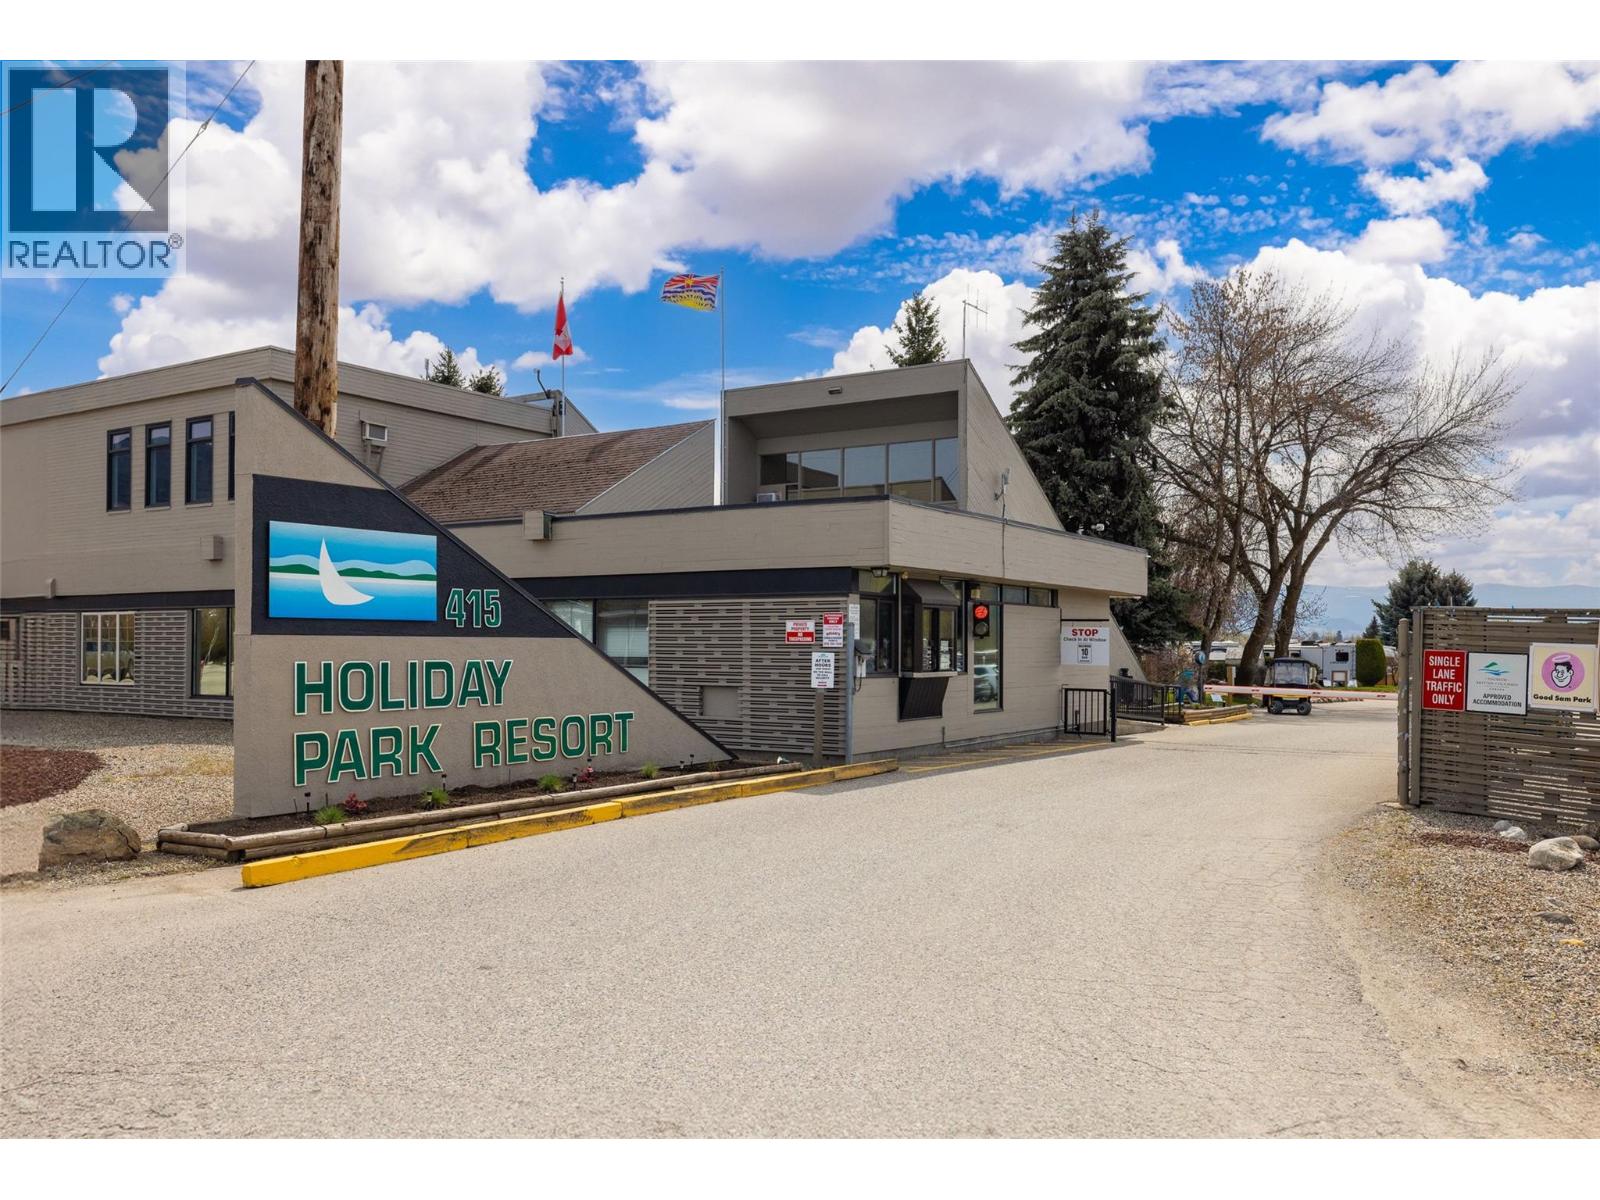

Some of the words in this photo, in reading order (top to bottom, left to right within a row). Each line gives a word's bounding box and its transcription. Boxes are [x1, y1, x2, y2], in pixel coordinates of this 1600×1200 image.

[445, 588, 502, 628] 415
[1429, 655, 1461, 668] SINGLE
[1432, 668, 1455, 680] LANE
[294, 659, 513, 716] HOLIDAY
[1425, 680, 1462, 693] TRAFFIC
[1431, 693, 1455, 705] ONLY
[1472, 698, 1522, 708] ACCOMMODATION
[1482, 693, 1512, 701] APPROVED
[1533, 693, 1554, 702] Good
[1555, 694, 1572, 703] Sam
[1573, 695, 1592, 704] Park
[293, 723, 443, 787] PARK
[473, 711, 635, 769] RESORT
